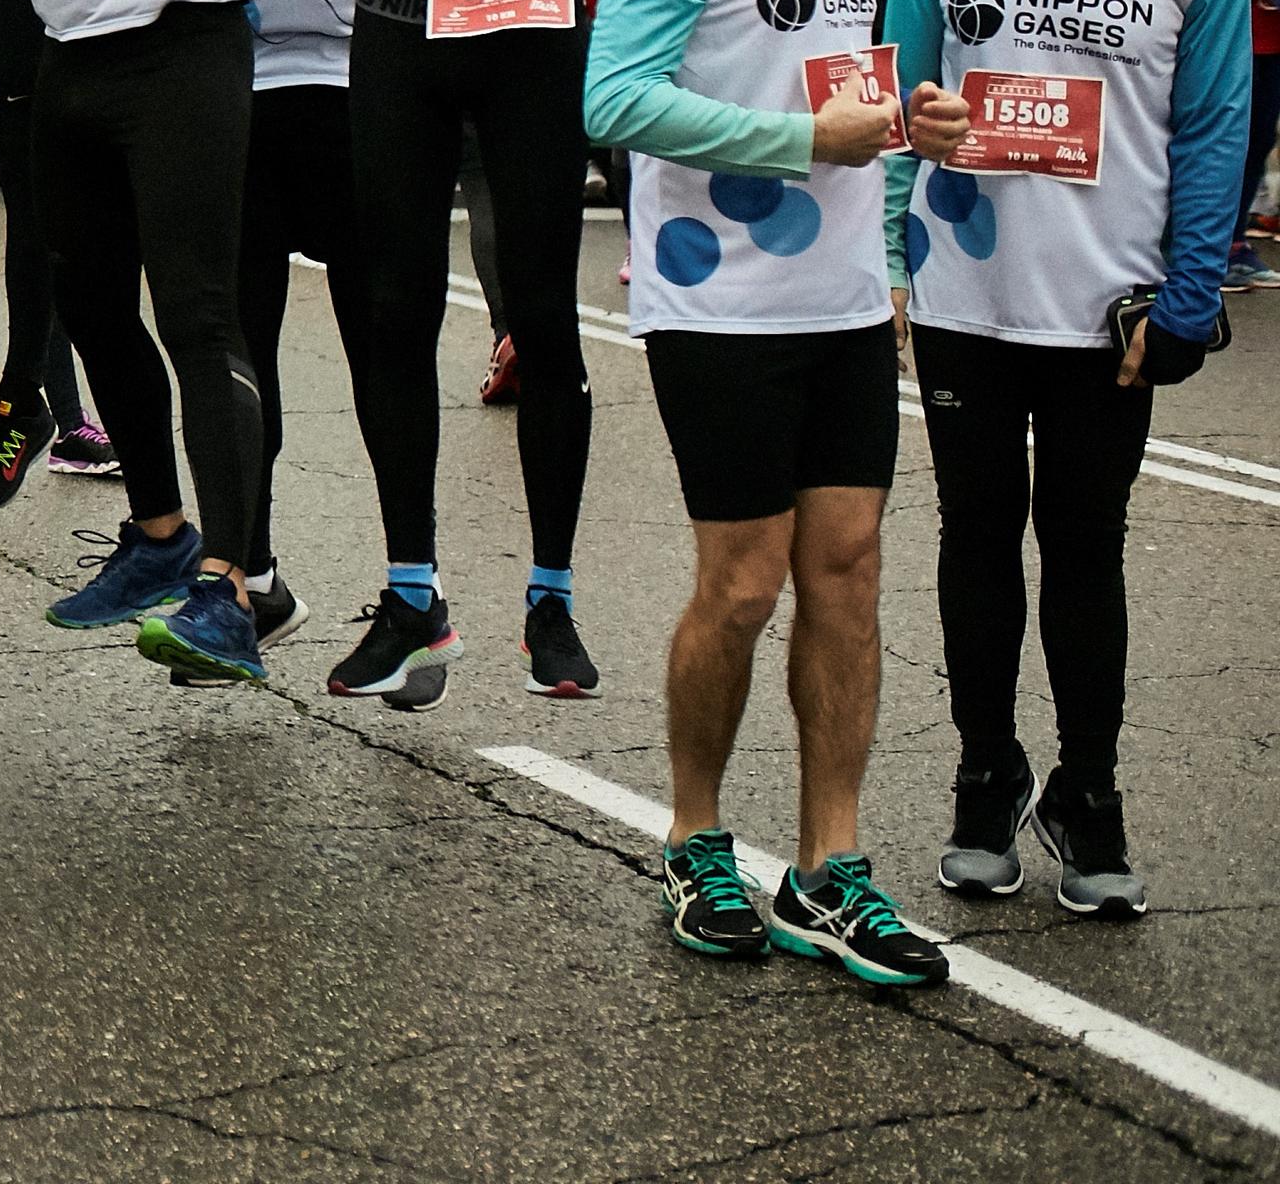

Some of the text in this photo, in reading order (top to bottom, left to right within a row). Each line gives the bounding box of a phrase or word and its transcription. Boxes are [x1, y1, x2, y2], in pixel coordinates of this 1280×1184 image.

[1013, 11, 1126, 49] GASES
[1013, 38, 1142, 67] The Gas Professionals
[983, 97, 1070, 128] 15508
[1007, 151, 1040, 162] 10 KM
